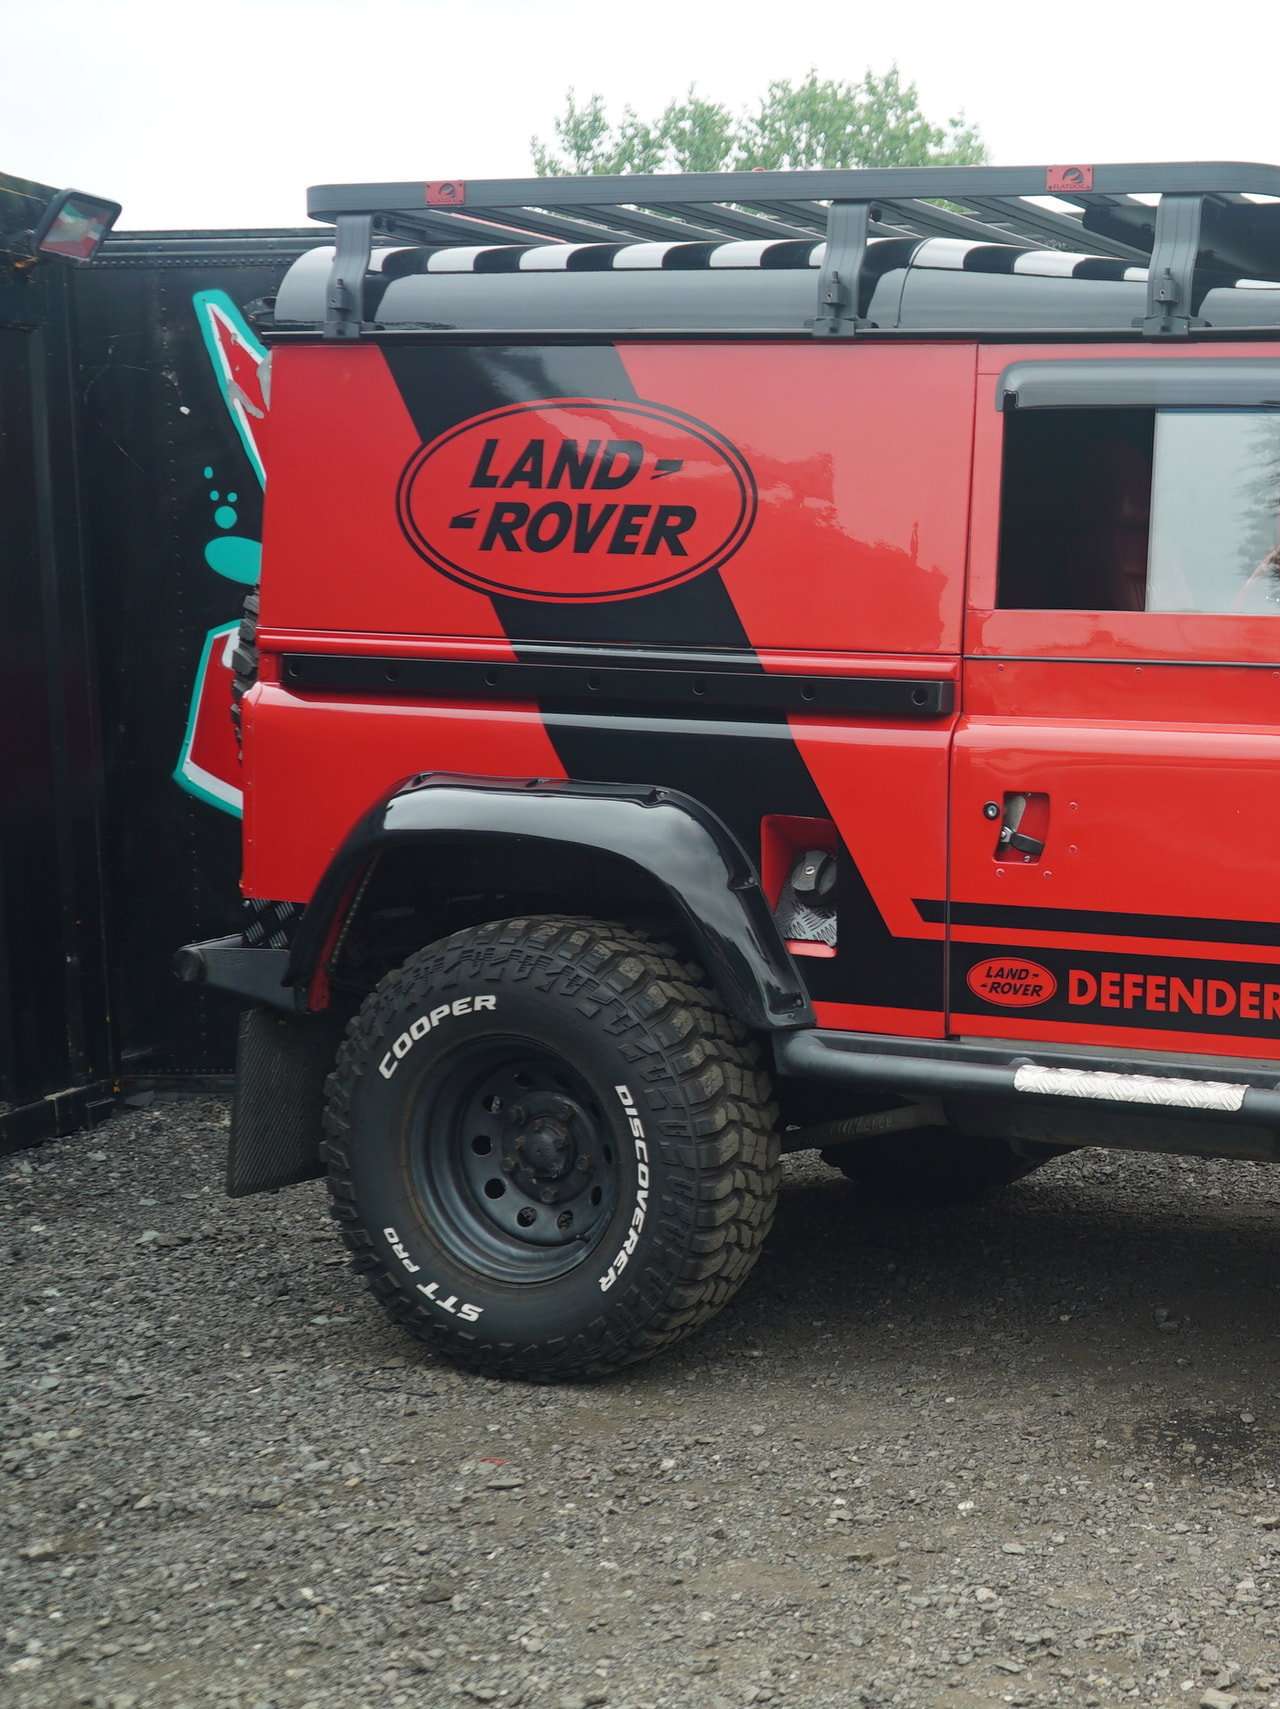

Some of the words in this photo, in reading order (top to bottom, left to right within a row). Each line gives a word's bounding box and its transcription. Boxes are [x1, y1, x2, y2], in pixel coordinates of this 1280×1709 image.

[469, 438, 645, 490] LAND
[477, 500, 698, 557] ROVER
[985, 965, 1030, 981] LAND
[988, 981, 1044, 997] ROVER
[378, 994, 497, 1080] COOPER
[598, 1084, 651, 1293] DISCOVERER
[383, 1227, 421, 1273] PRO
[415, 1281, 485, 1323] STT
